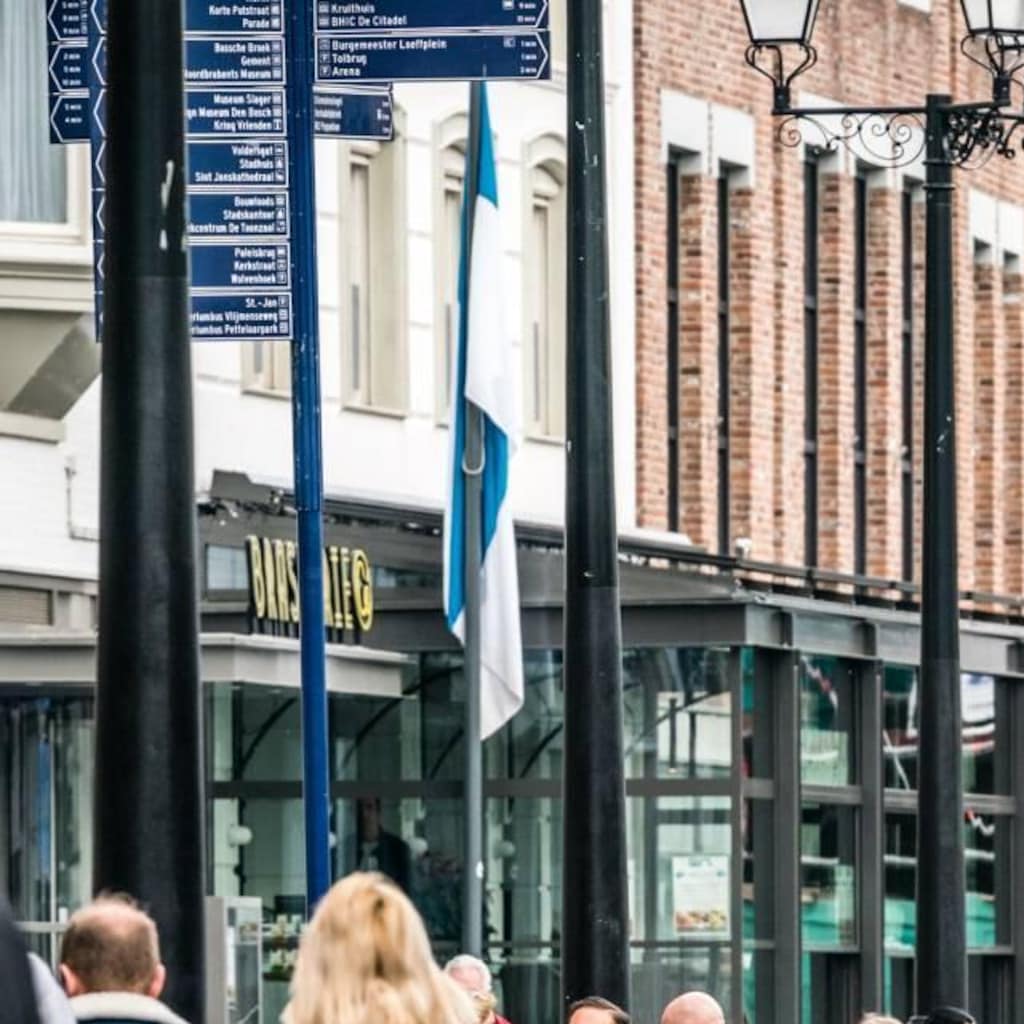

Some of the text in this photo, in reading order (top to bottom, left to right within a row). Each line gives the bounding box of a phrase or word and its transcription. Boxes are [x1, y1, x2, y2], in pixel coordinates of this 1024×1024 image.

[208, 5, 270, 16] Korte Putstraat
[331, 4, 375, 14] Kruithuis
[332, 15, 408, 27] BHIC De Citadel
[331, 40, 398, 53] Burgemeester
[331, 53, 367, 66] Tolbrug
[240, 68, 272, 79] Museum
[331, 66, 361, 76] Arena
[213, 93, 245, 104] Museum
[231, 106, 247, 117] Den
[228, 222, 240, 233] De
